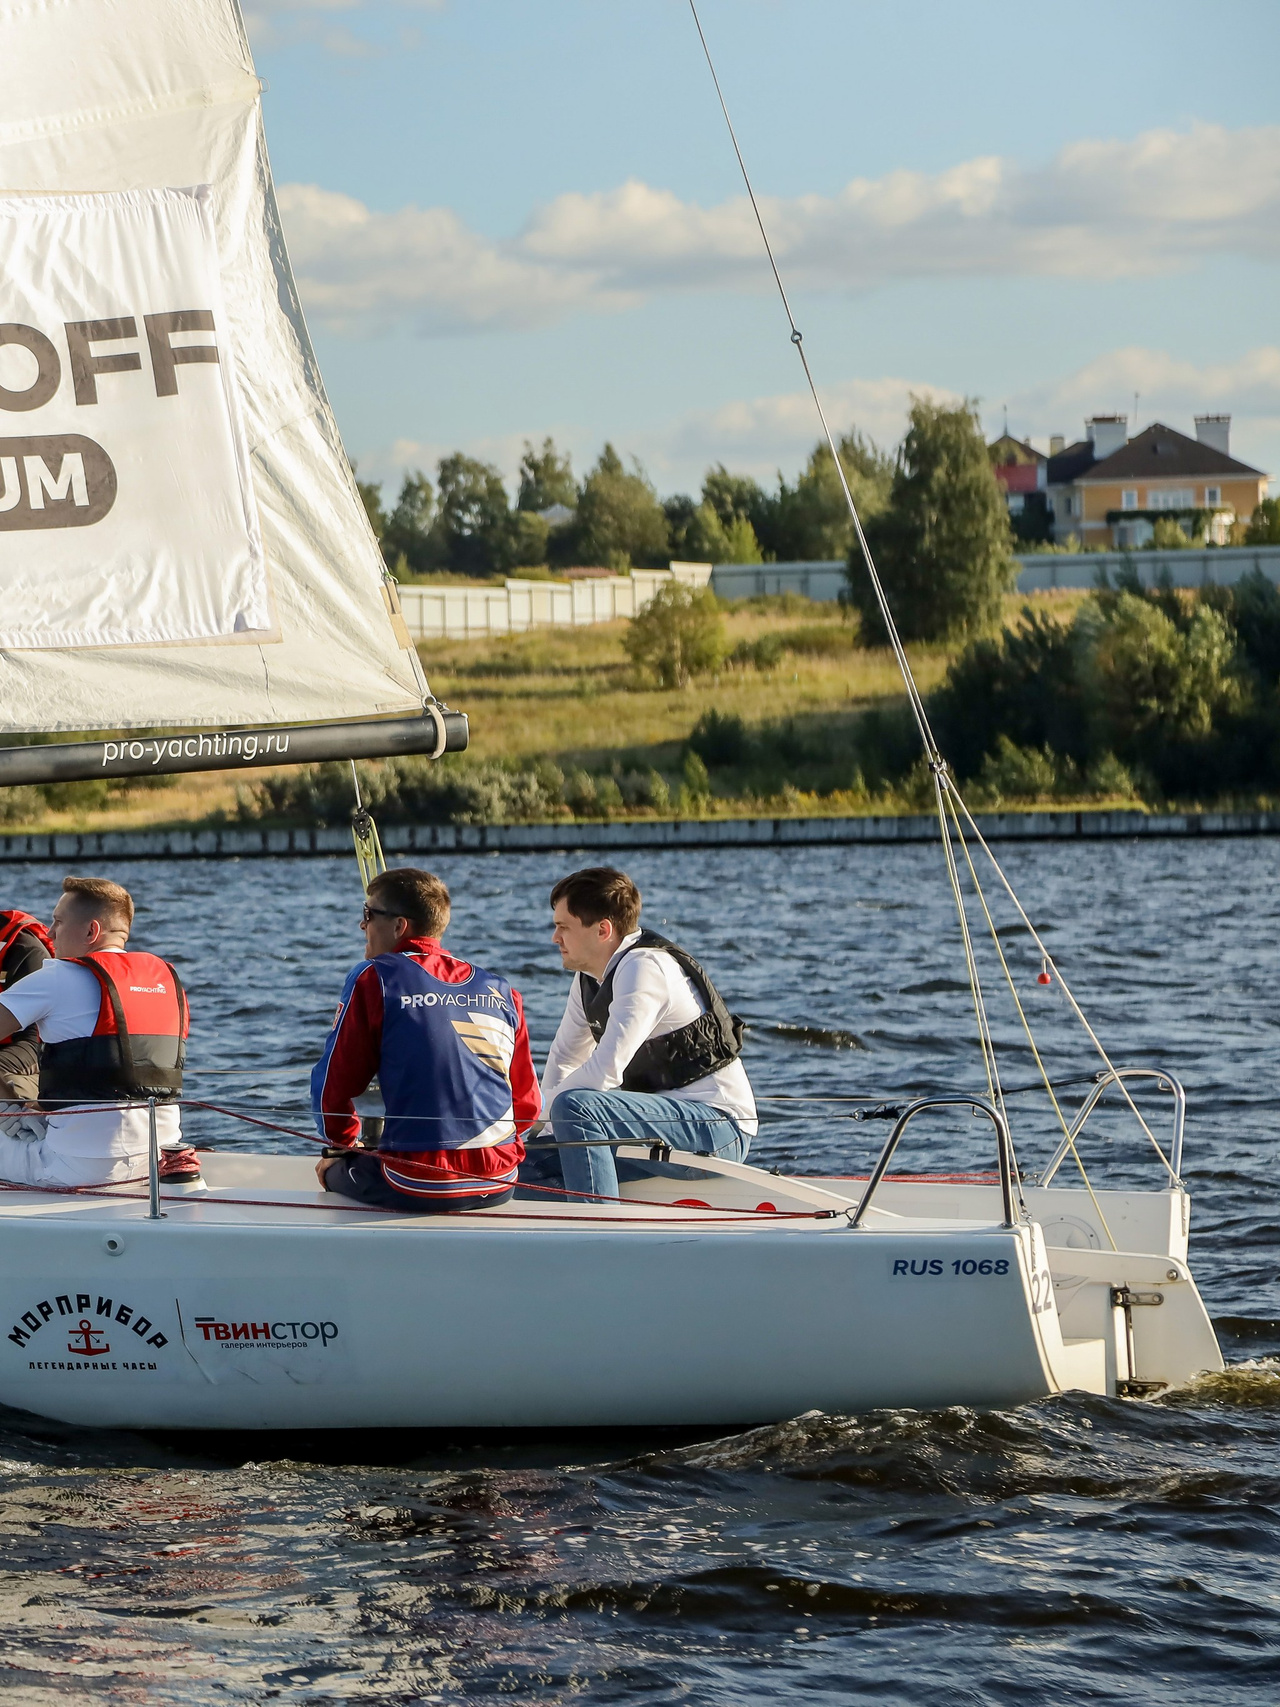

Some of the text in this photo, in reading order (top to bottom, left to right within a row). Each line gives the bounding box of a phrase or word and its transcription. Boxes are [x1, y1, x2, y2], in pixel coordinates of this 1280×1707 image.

[102, 732, 290, 767] pro-yachting.ru
[892, 1259, 1010, 1276] RUS 1068
[1031, 1269, 1052, 1314] 22
[7, 1294, 169, 1349] МОРПРИБОР
[220, 1341, 308, 1349] галерея интерьеров
[29, 1361, 157, 1370] ЛЕГЕНДАРНЫЕ ЧАСЫ
